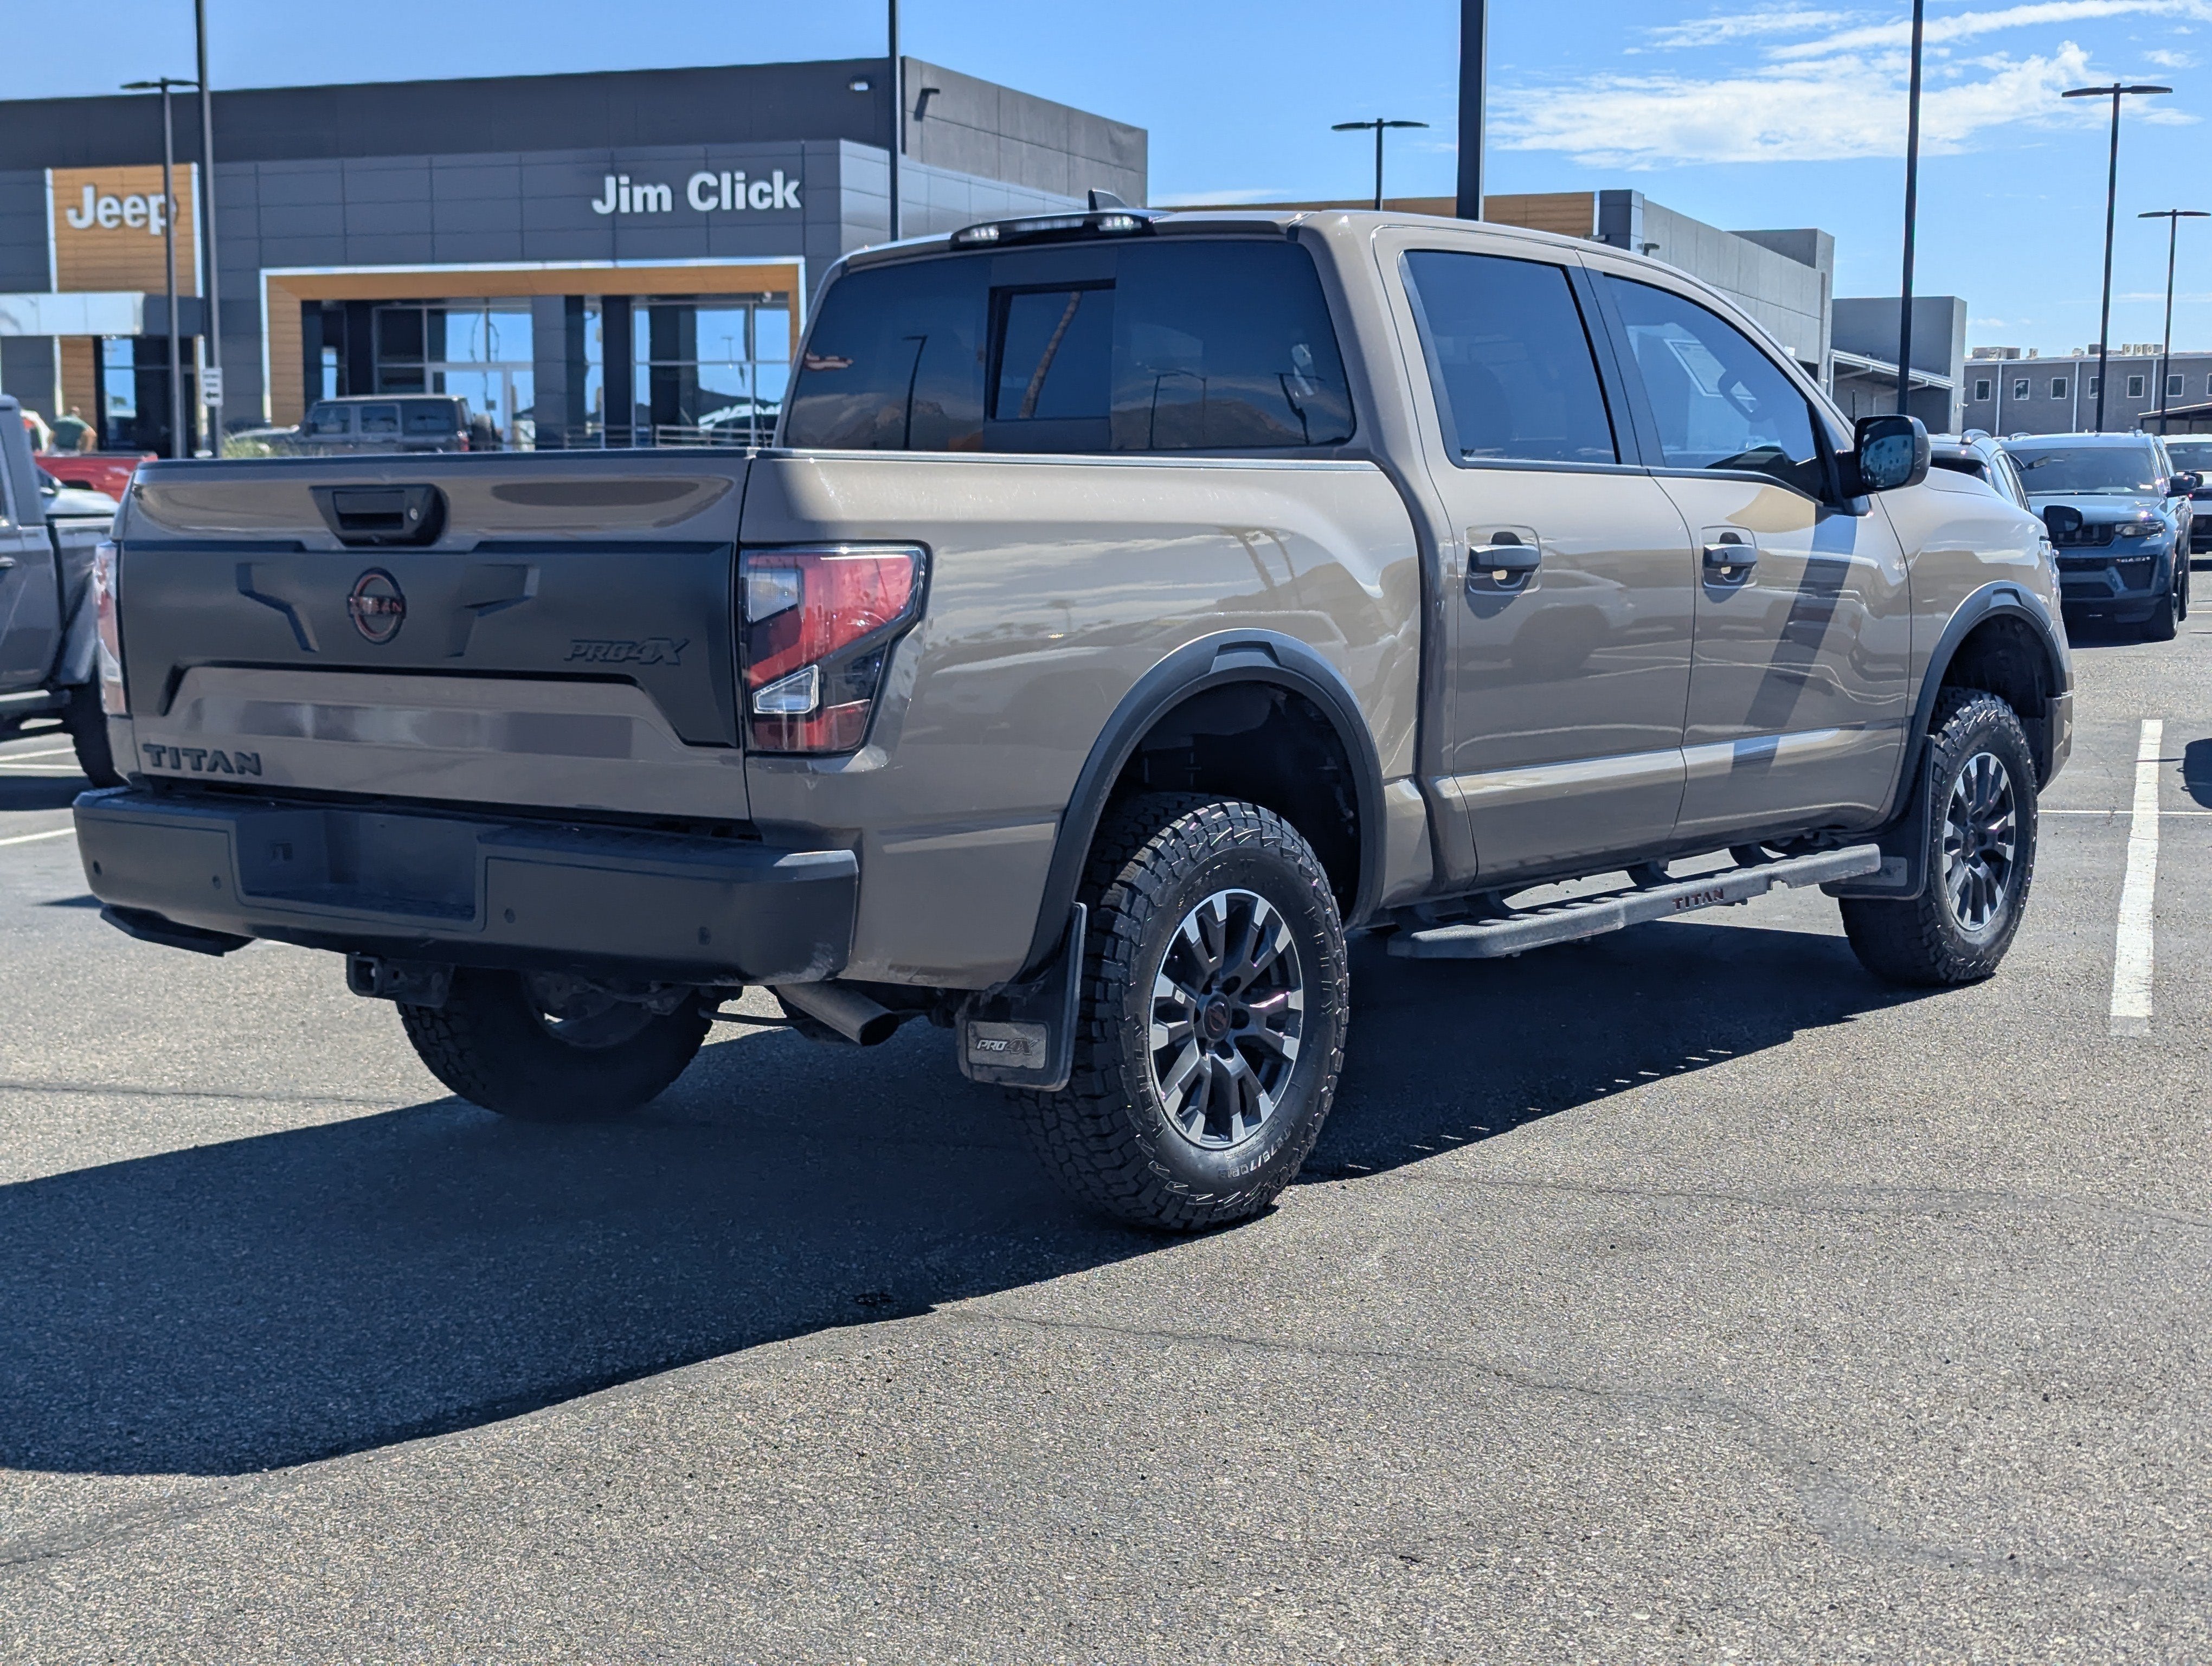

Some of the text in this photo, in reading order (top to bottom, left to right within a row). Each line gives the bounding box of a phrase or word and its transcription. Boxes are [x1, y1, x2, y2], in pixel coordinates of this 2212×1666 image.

[65, 184, 178, 236] Jeep
[591, 170, 802, 214] Jim Click
[142, 743, 262, 776] TITAN
[1672, 888, 1724, 910] TITAN
